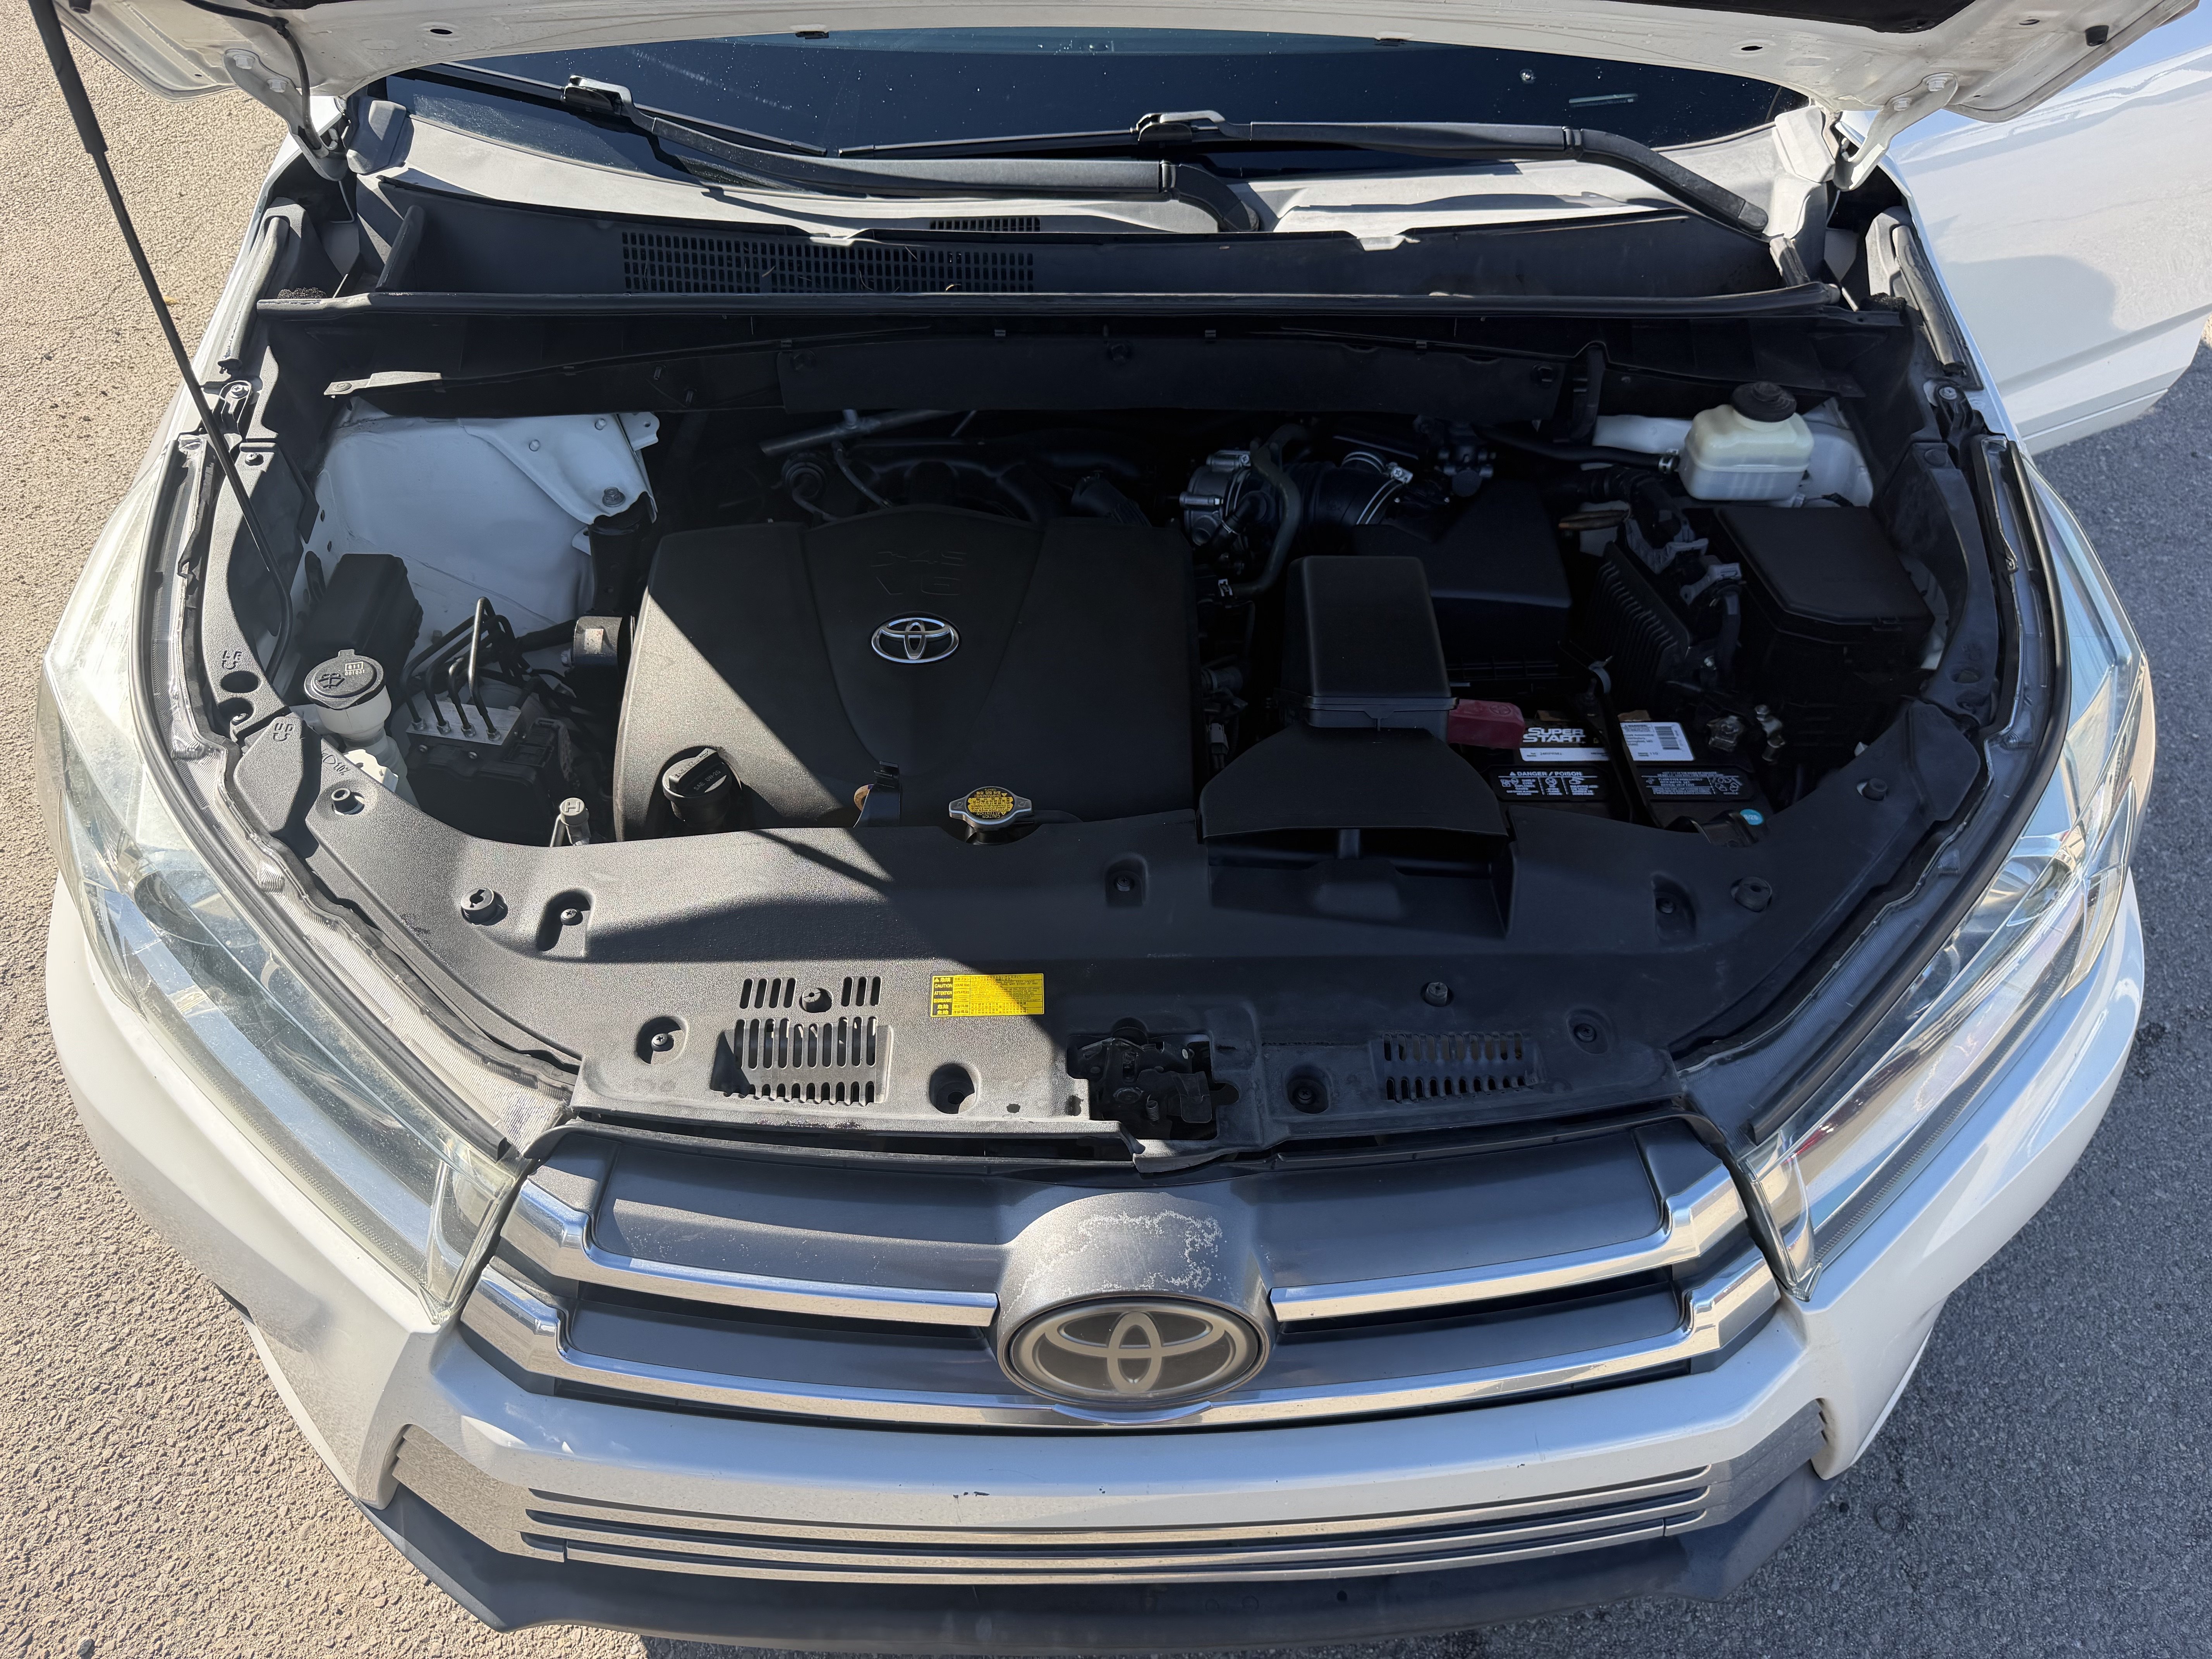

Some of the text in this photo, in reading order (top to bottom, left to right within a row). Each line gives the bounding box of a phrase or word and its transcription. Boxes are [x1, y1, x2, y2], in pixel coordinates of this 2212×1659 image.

[1528, 727, 1584, 735] SUPER
[1523, 733, 1586, 743] START
[693, 770, 721, 791] SAE 0W-20
[565, 801, 580, 813] H
